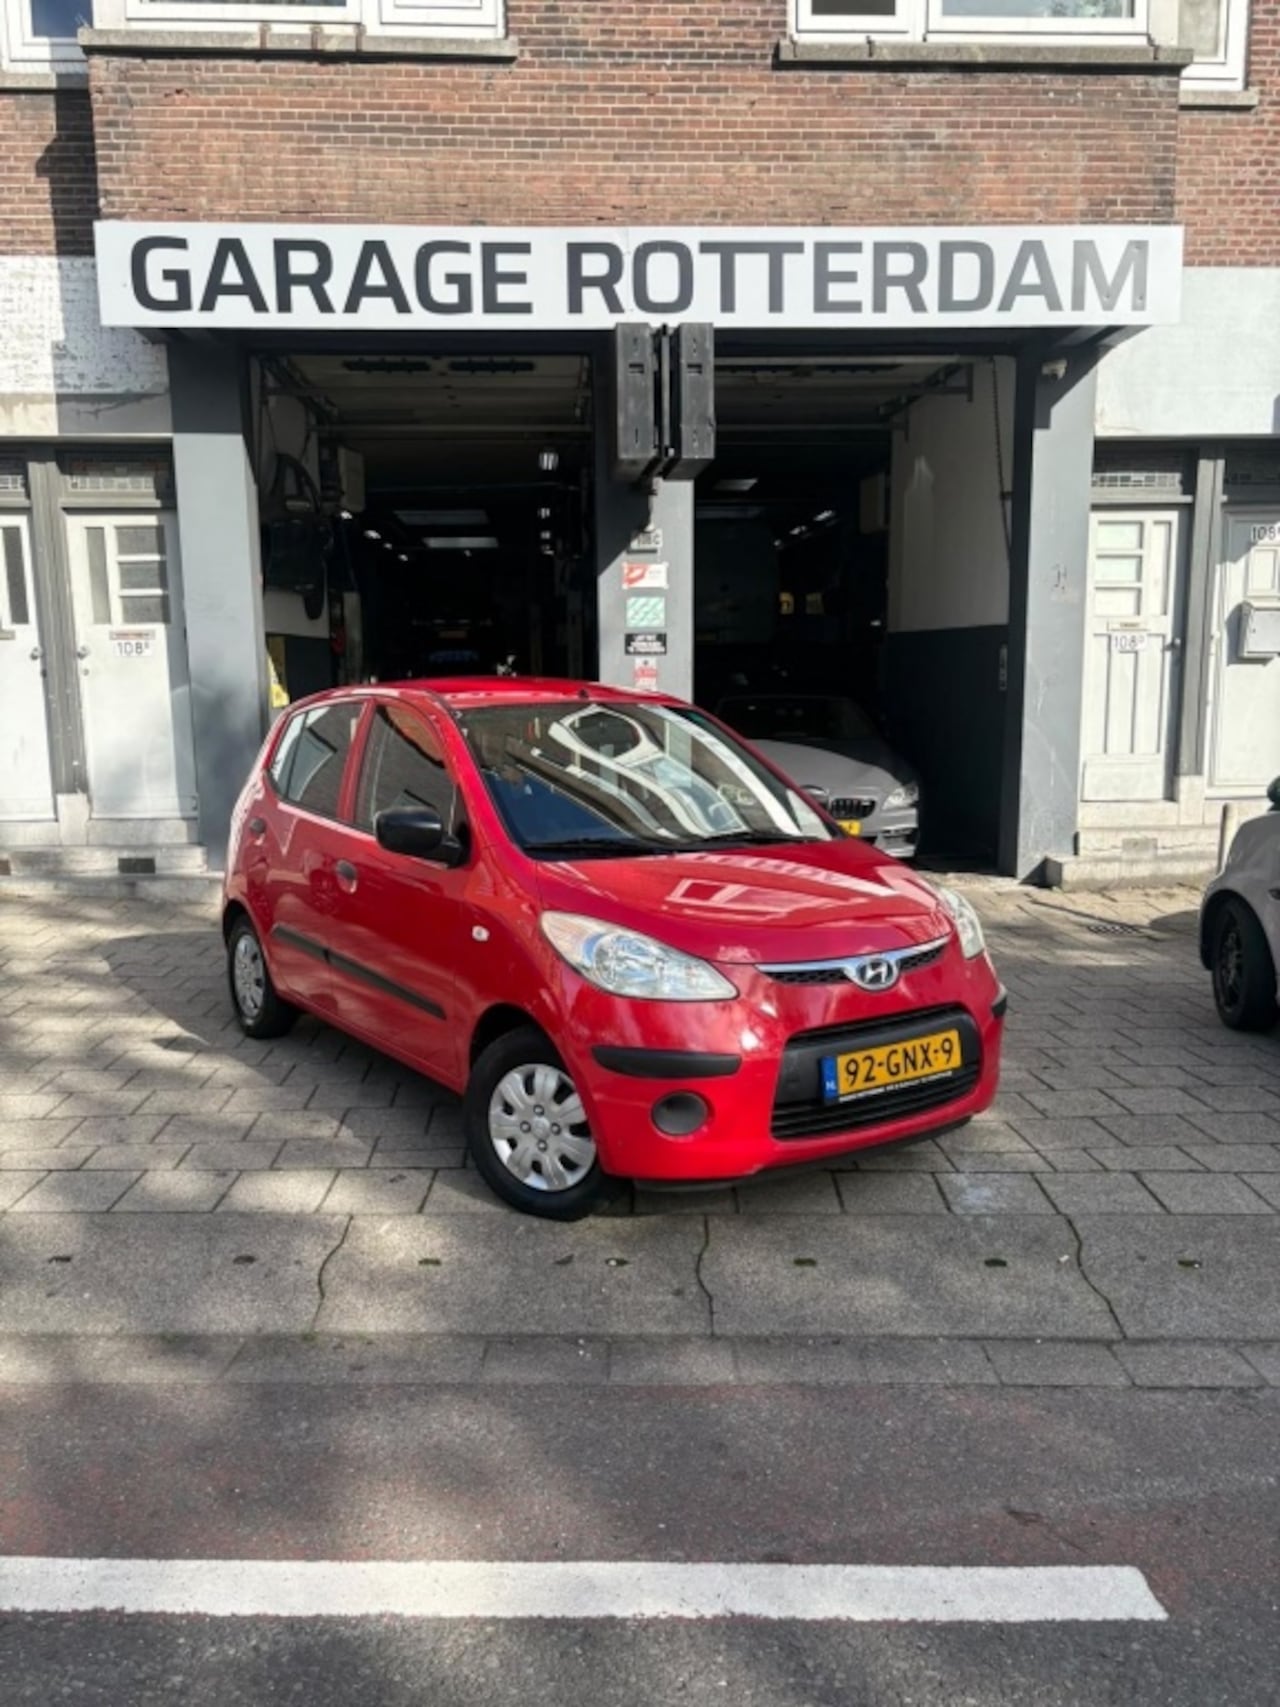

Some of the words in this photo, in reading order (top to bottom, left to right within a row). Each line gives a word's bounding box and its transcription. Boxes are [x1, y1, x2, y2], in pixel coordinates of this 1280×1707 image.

[131, 236, 533, 315] GARAGE
[567, 239, 1149, 315] ROTTERDAM
[845, 1038, 954, 1087] 92-GNX-9
